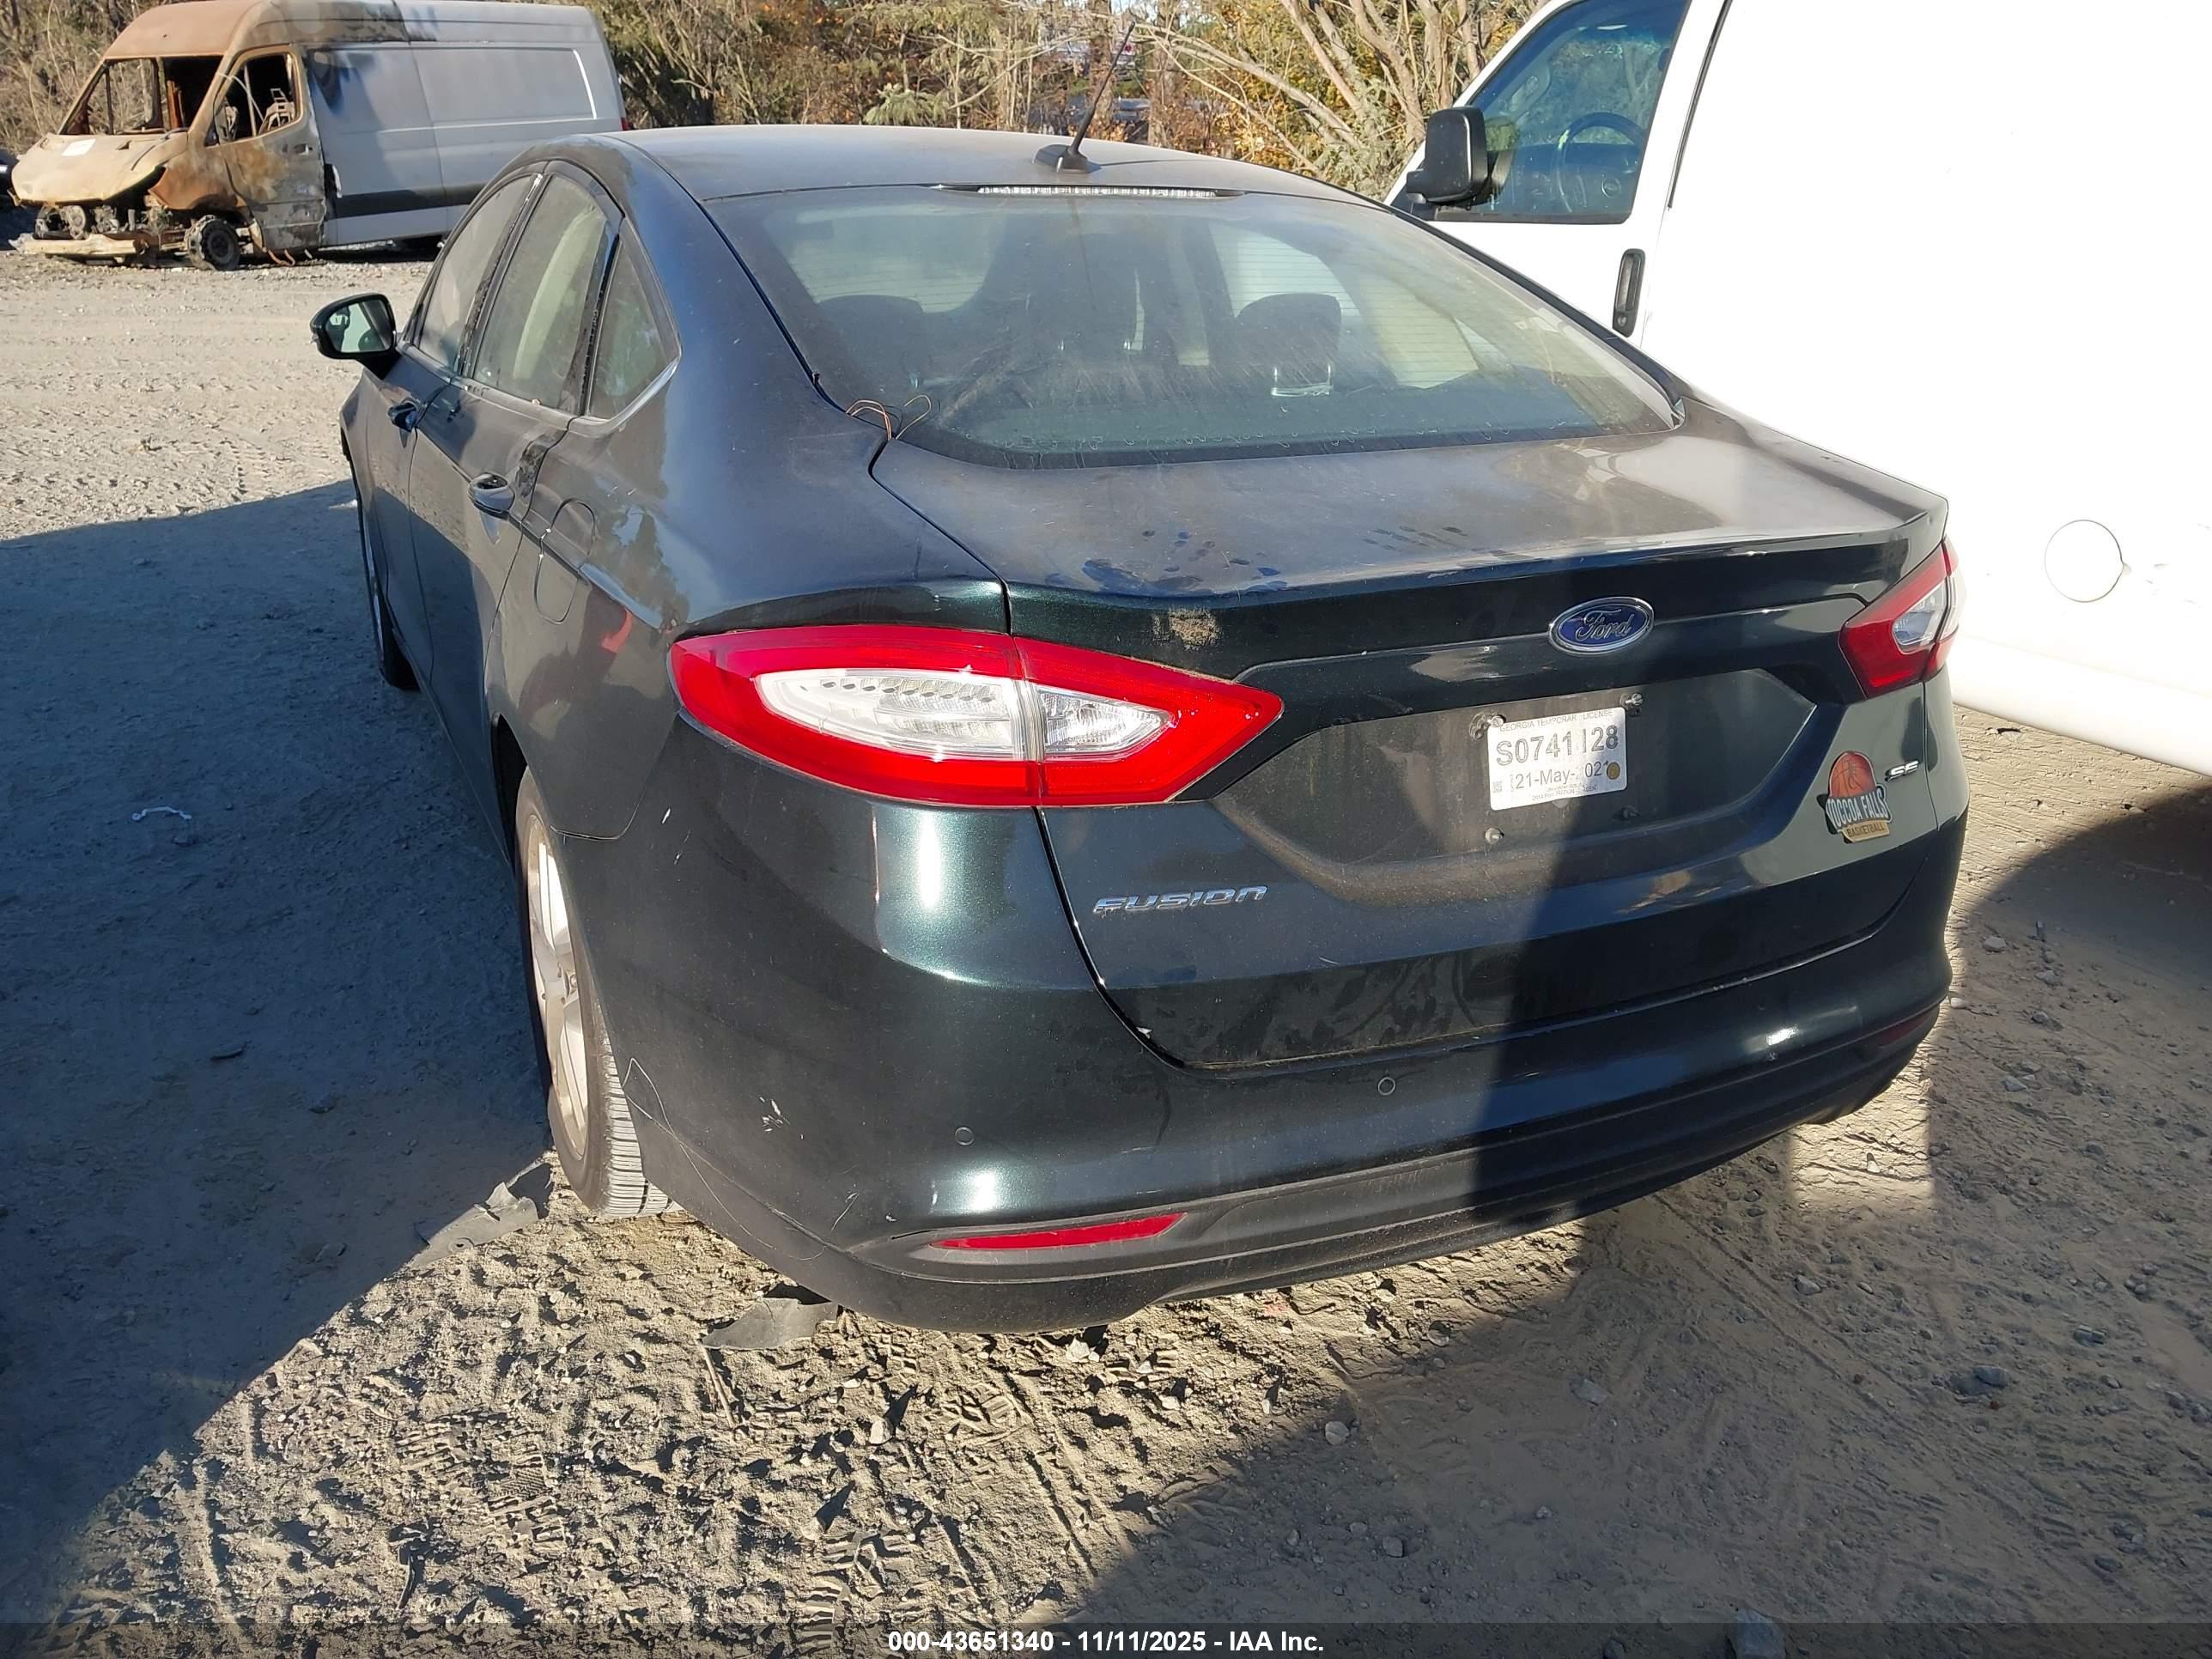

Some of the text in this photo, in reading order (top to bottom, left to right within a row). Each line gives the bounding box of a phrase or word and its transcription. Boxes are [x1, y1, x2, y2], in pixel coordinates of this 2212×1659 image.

[1575, 609, 1635, 642] Ford
[1499, 708, 1613, 732] GEORGIA TEMPORAR LICENSE
[1888, 759, 1919, 778] SE
[1860, 788, 1889, 819] FALLS
[1846, 821, 1886, 838] BASKETBALL
[1092, 884, 1269, 914] FUSION
